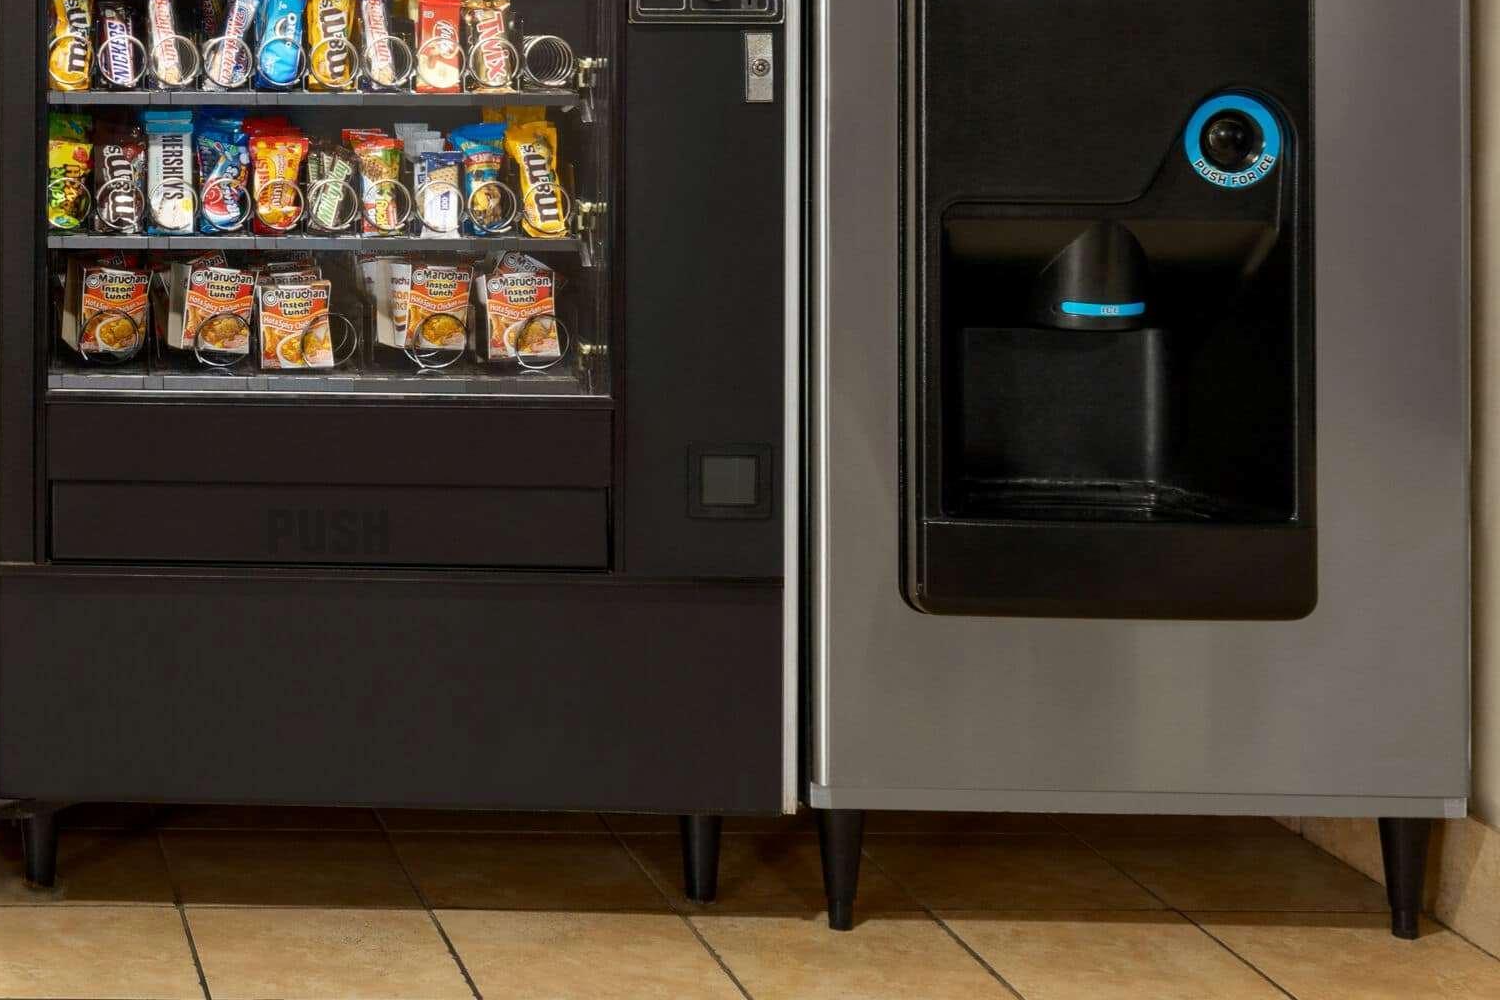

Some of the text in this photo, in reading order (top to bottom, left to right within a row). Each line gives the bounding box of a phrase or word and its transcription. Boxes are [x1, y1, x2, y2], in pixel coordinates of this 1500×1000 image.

[1195, 155, 1276, 185] PUSH FOR ICE
[99, 274, 148, 284] Maruchan
[204, 271, 253, 284] Maruchan
[423, 269, 469, 281] Maruchan
[426, 282, 457, 290] Instant
[500, 276, 550, 287] Maruchan
[102, 286, 135, 294] Instant
[206, 284, 241, 292] Instant
[505, 288, 537, 296] Instant
[275, 289, 326, 300] Maruchan
[508, 295, 535, 303] Lunch
[284, 308, 310, 316] Lunch
[268, 509, 389, 553] PUSH
